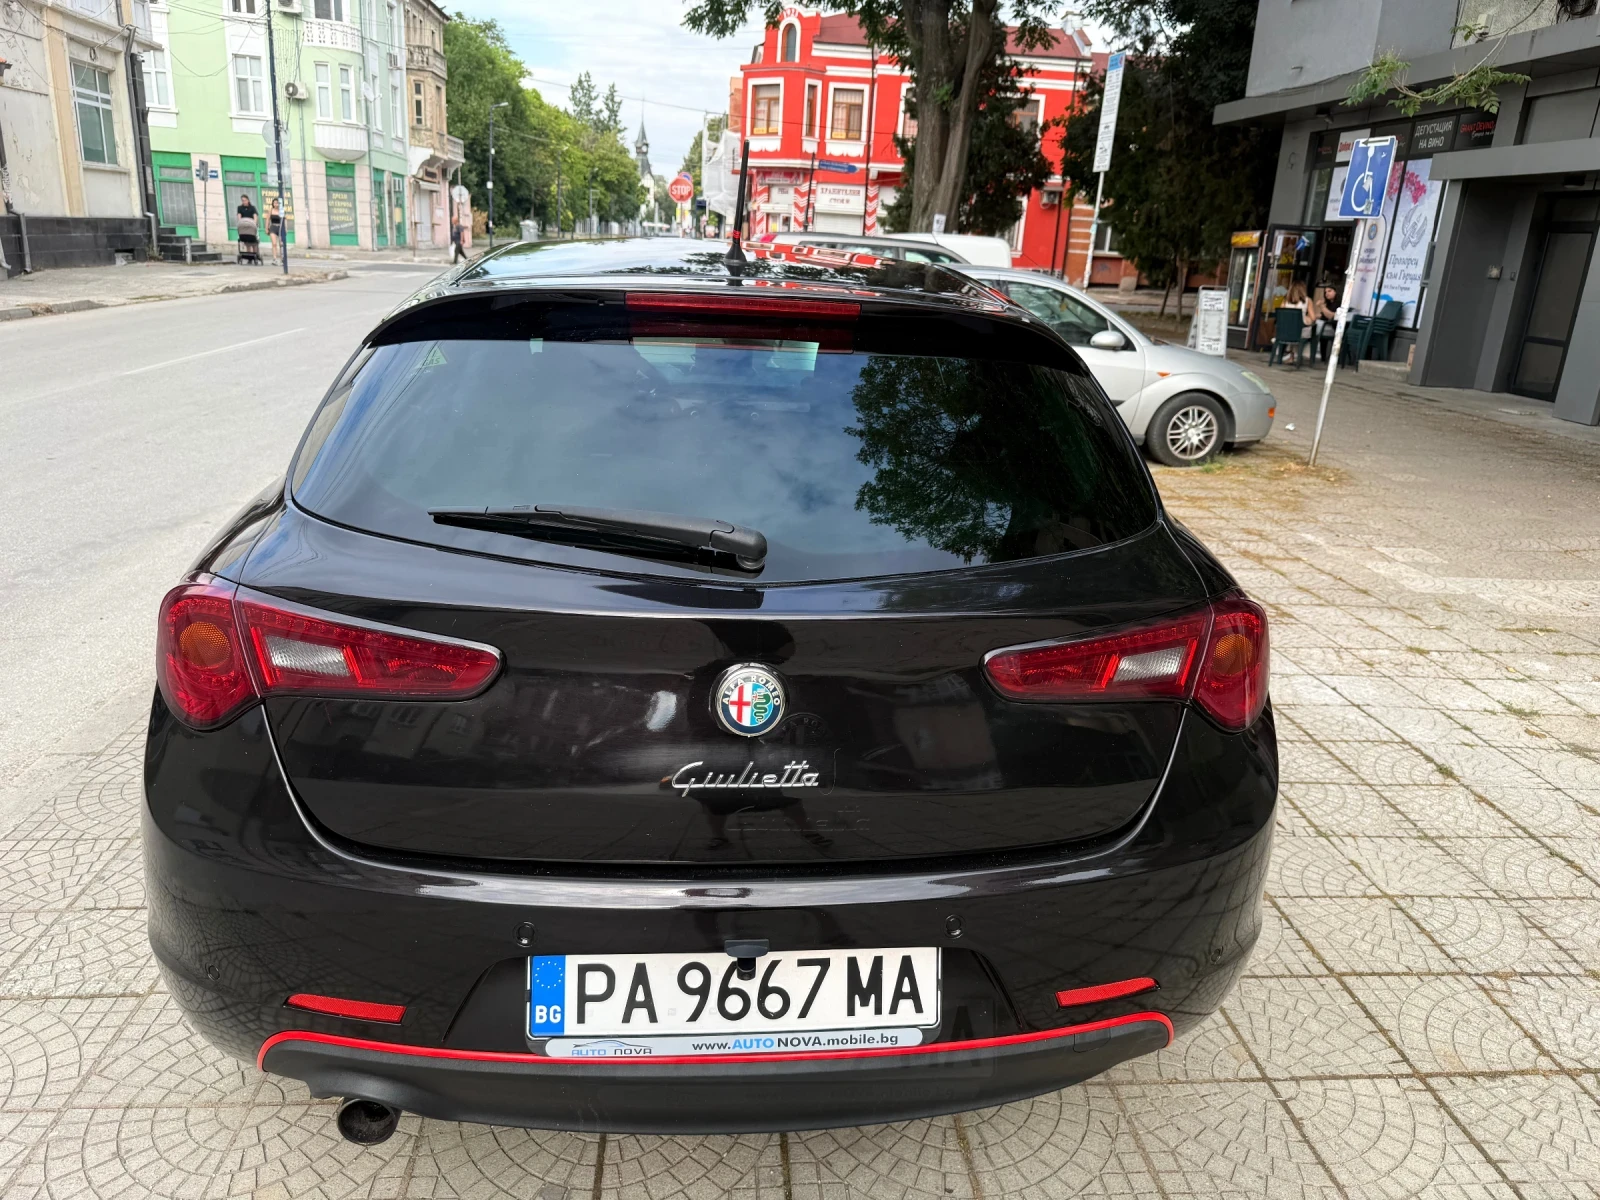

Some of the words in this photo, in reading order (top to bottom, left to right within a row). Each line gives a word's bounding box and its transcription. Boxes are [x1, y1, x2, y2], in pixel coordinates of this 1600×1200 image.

[1415, 121, 1453, 137] ДЕГУСТАЦИЯ
[1418, 139, 1427, 149] НА
[1428, 137, 1445, 148] ВИНО
[671, 185, 691, 196] STOP
[722, 677, 745, 705] ALFA
[750, 675, 781, 706] ROMEO
[671, 760, 820, 798] Giulietta
[576, 962, 659, 1025] PA
[676, 956, 831, 1022] 9667
[846, 954, 924, 1017] MA
[535, 1005, 562, 1024] BG
[571, 1048, 607, 1056] AUTO
